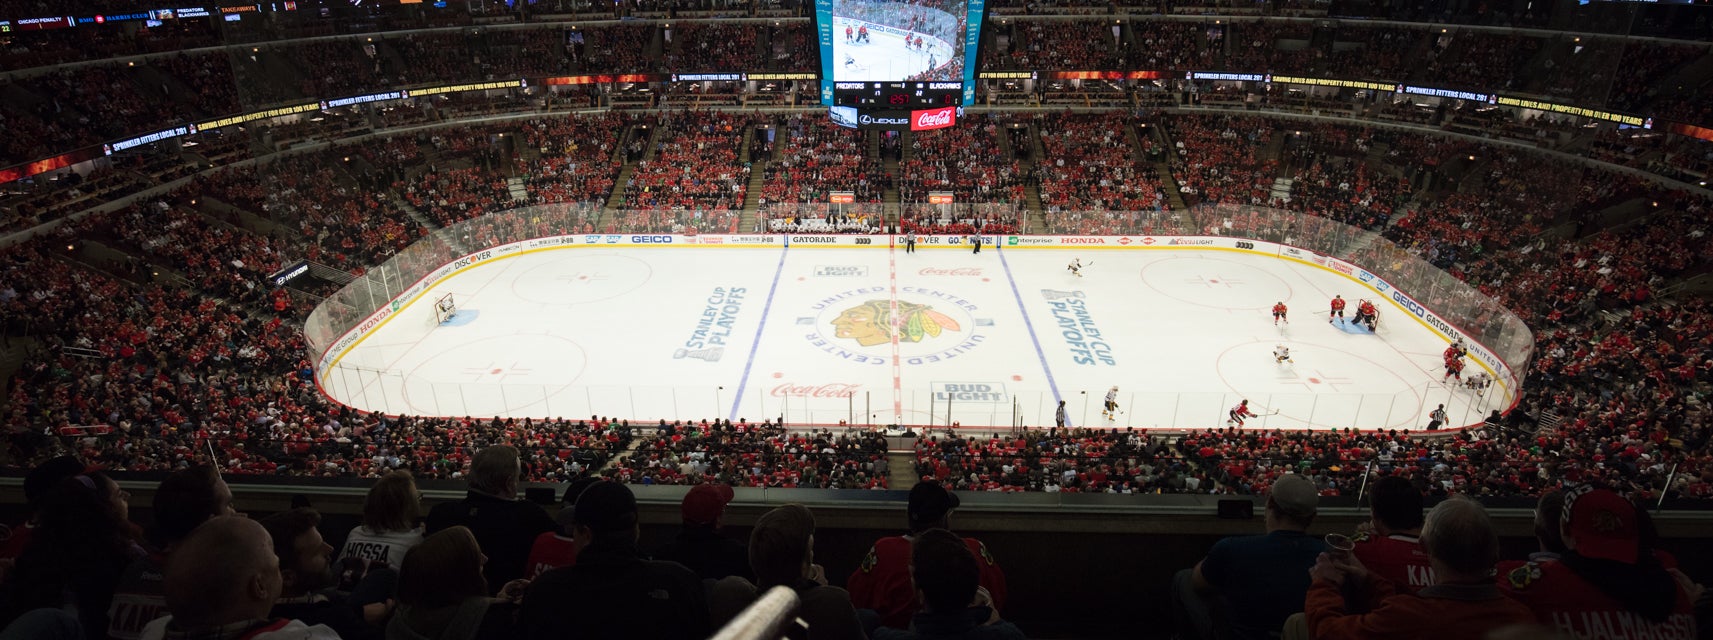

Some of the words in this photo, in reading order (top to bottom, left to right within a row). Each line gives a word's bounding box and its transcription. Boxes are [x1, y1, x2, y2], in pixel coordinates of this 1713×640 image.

[221, 5, 256, 13] TAKEAWAYS
[1316, 79, 1343, 87] PROPERTY
[328, 98, 355, 107] SPRINKLER
[354, 95, 375, 103] FITTERS
[1405, 86, 1436, 95] SPRINKLER
[1435, 89, 1459, 98] FITTERS
[1458, 92, 1476, 100] LOCAL
[197, 121, 218, 131] SAVING
[217, 118, 233, 127] LIVES
[232, 116, 243, 124] AND
[268, 109, 279, 117] FOR
[279, 107, 293, 115] OVER
[293, 105, 303, 113] 100
[302, 103, 320, 111] YEARS
[918, 110, 951, 127] Coca-Cola
[1498, 97, 1520, 106] SAVING
[1520, 100, 1538, 108] LIVES
[1551, 104, 1582, 115] PROPERTY
[1582, 109, 1594, 117] FOR
[1610, 114, 1622, 122] 100
[1621, 116, 1643, 125] YEARS
[872, 117, 908, 125] LEXUS
[112, 138, 141, 151] SPRINKLER
[140, 134, 160, 145] FITTERS
[159, 130, 177, 140] LOCAL
[585, 235, 601, 243] SAP
[606, 235, 622, 243] SAP
[632, 235, 672, 243] GEICO
[899, 236, 939, 244] DICOVER
[970, 236, 993, 244] NTS!
[454, 251, 491, 269] DISCOVER
[285, 264, 308, 281] HYUNDAI
[918, 267, 983, 276] Coca-Cola
[812, 286, 885, 310] UNITED
[902, 286, 978, 311] CENTER
[360, 308, 393, 334] HONDA
[686, 306, 719, 349] STANLEY
[708, 286, 727, 306] CUP
[708, 287, 747, 346] PLAYOFFS
[1393, 290, 1424, 318] GEICO
[1426, 314, 1459, 340] GATORAD
[341, 332, 359, 349] Group
[1047, 301, 1096, 366] PLAYOFFS
[1066, 298, 1103, 341] STANLEY
[1090, 341, 1116, 366] CUP
[806, 332, 885, 365] CENTER
[907, 334, 985, 365] UNITED
[1469, 344, 1496, 366] UNITED
[770, 383, 863, 398] Coca-Cola
[936, 392, 1001, 401] LIGHT
[944, 384, 992, 392] BUD
[346, 542, 390, 563] HOSSA
